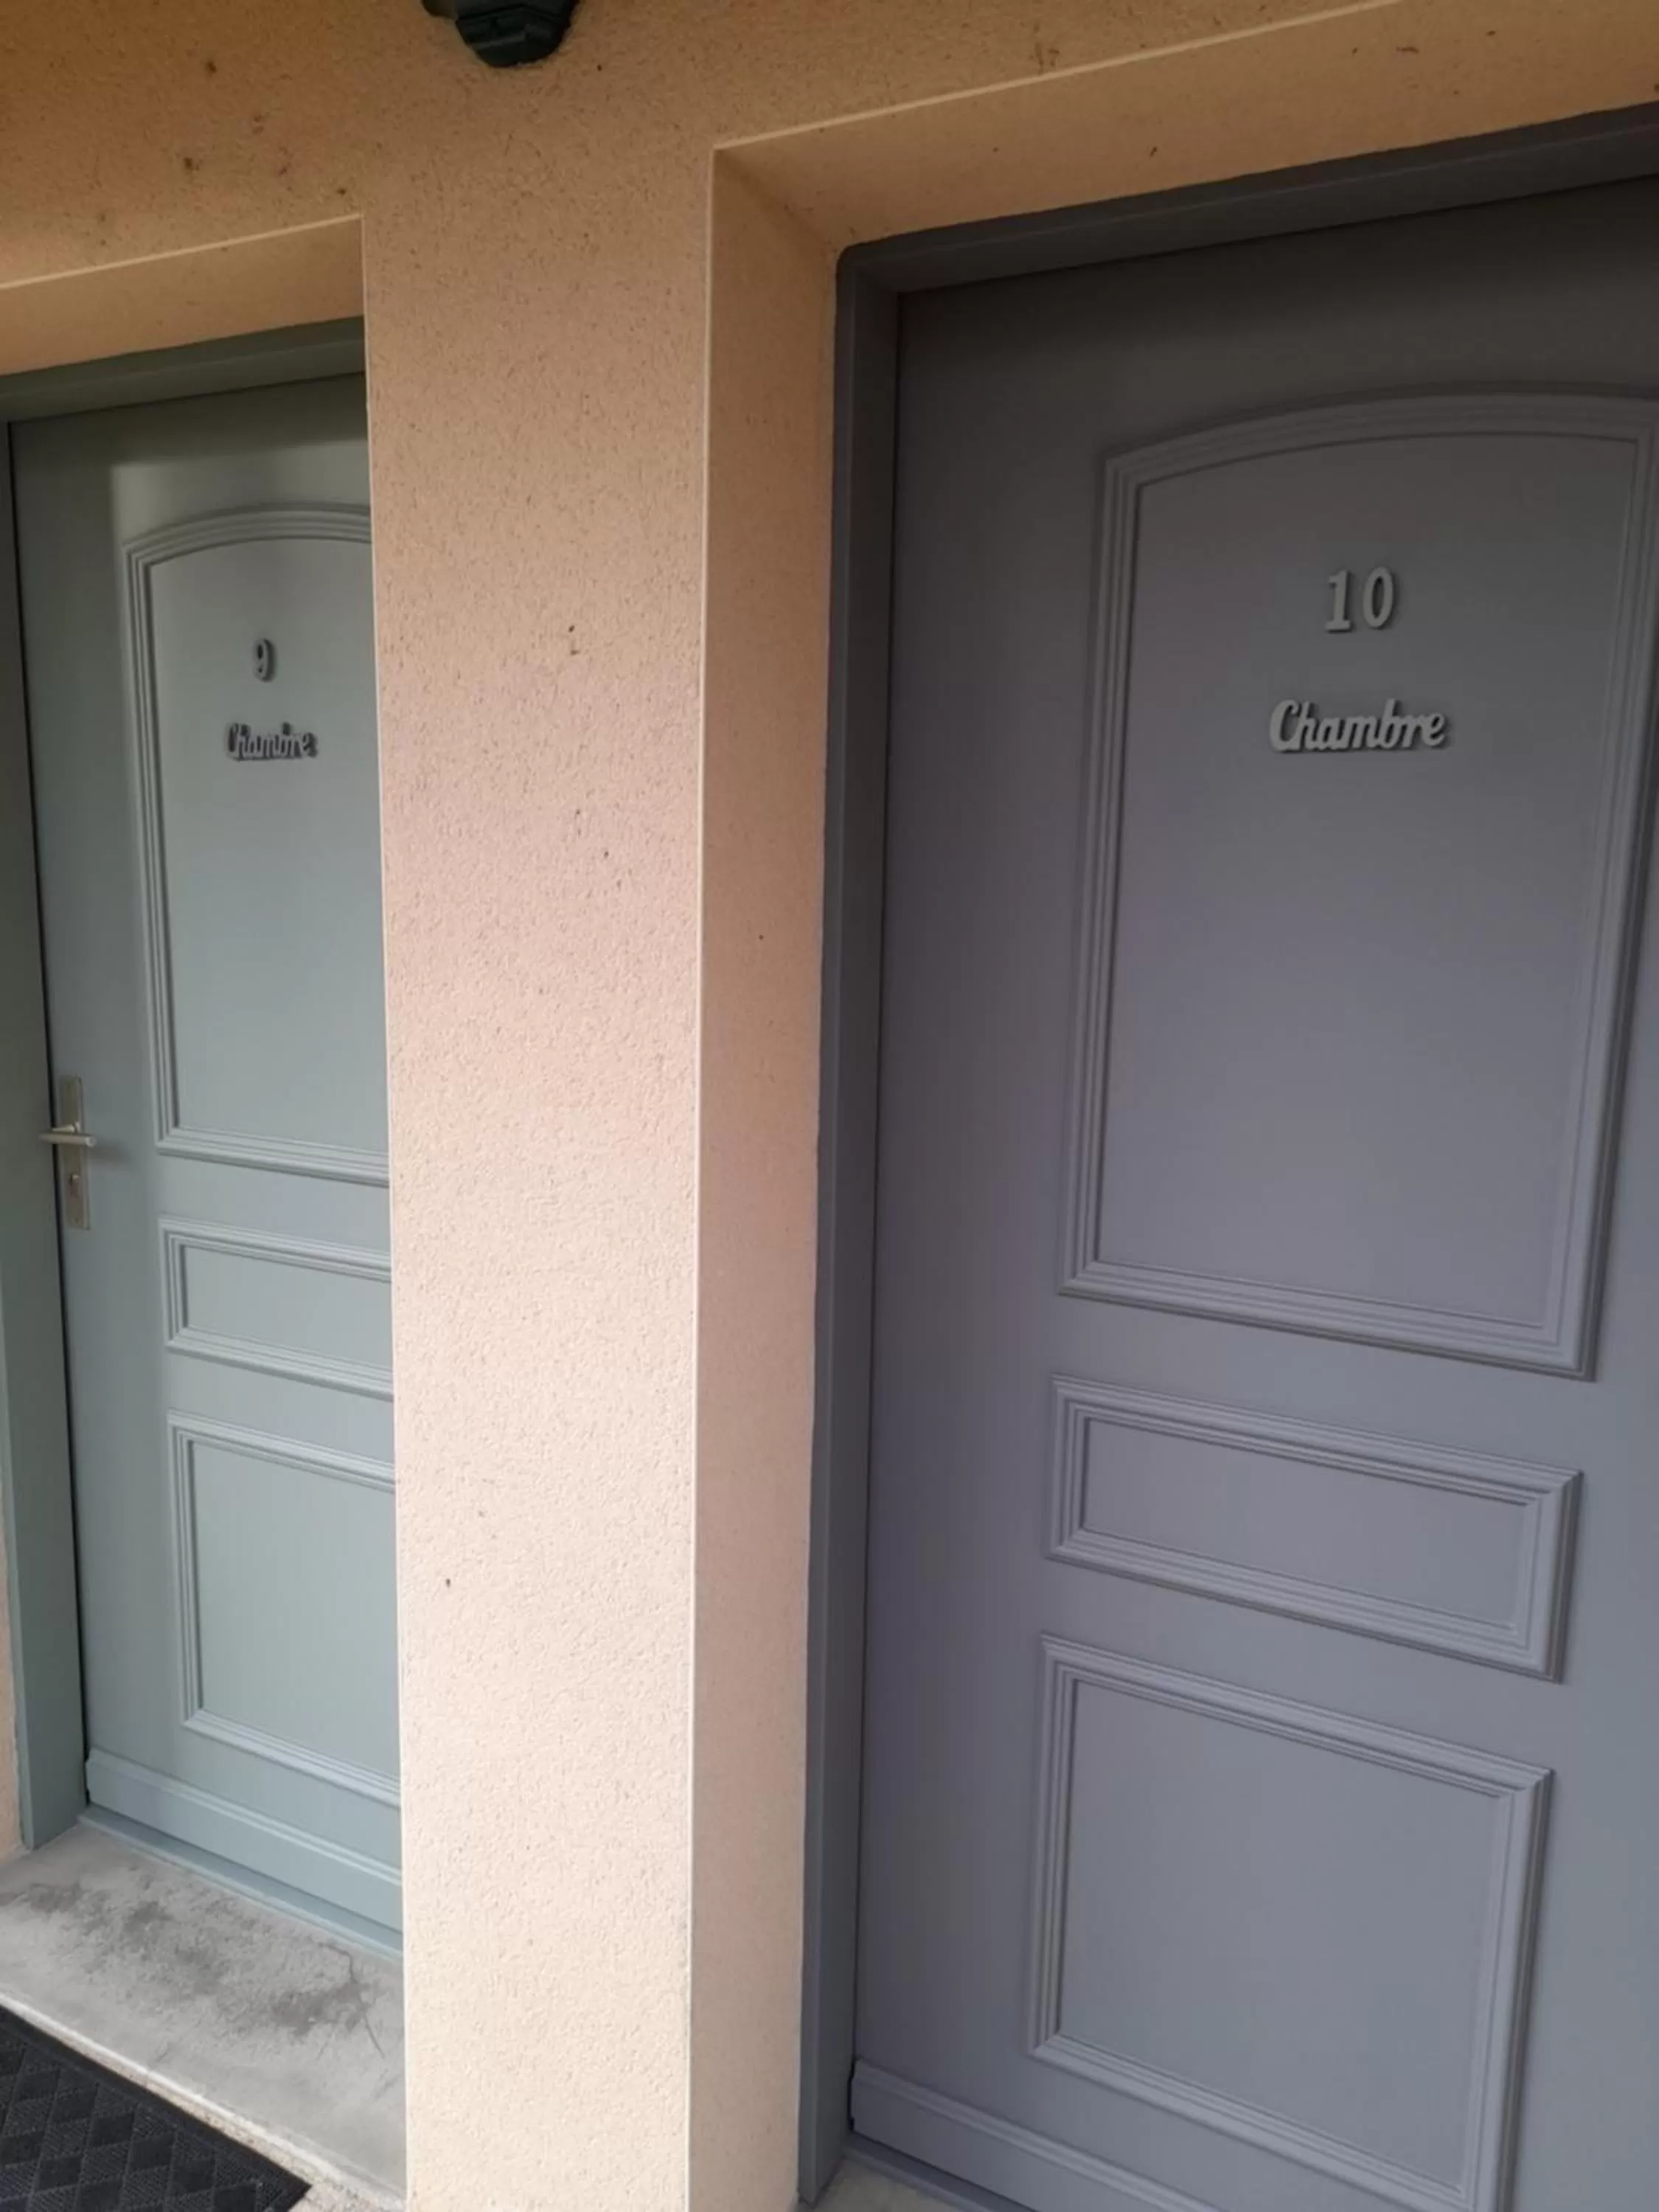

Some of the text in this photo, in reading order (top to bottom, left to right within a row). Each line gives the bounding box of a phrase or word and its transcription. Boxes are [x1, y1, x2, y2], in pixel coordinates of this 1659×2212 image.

[1324, 566, 1396, 632] 10
[253, 637, 277, 683] 9
[1269, 698, 1447, 752] Chambre
